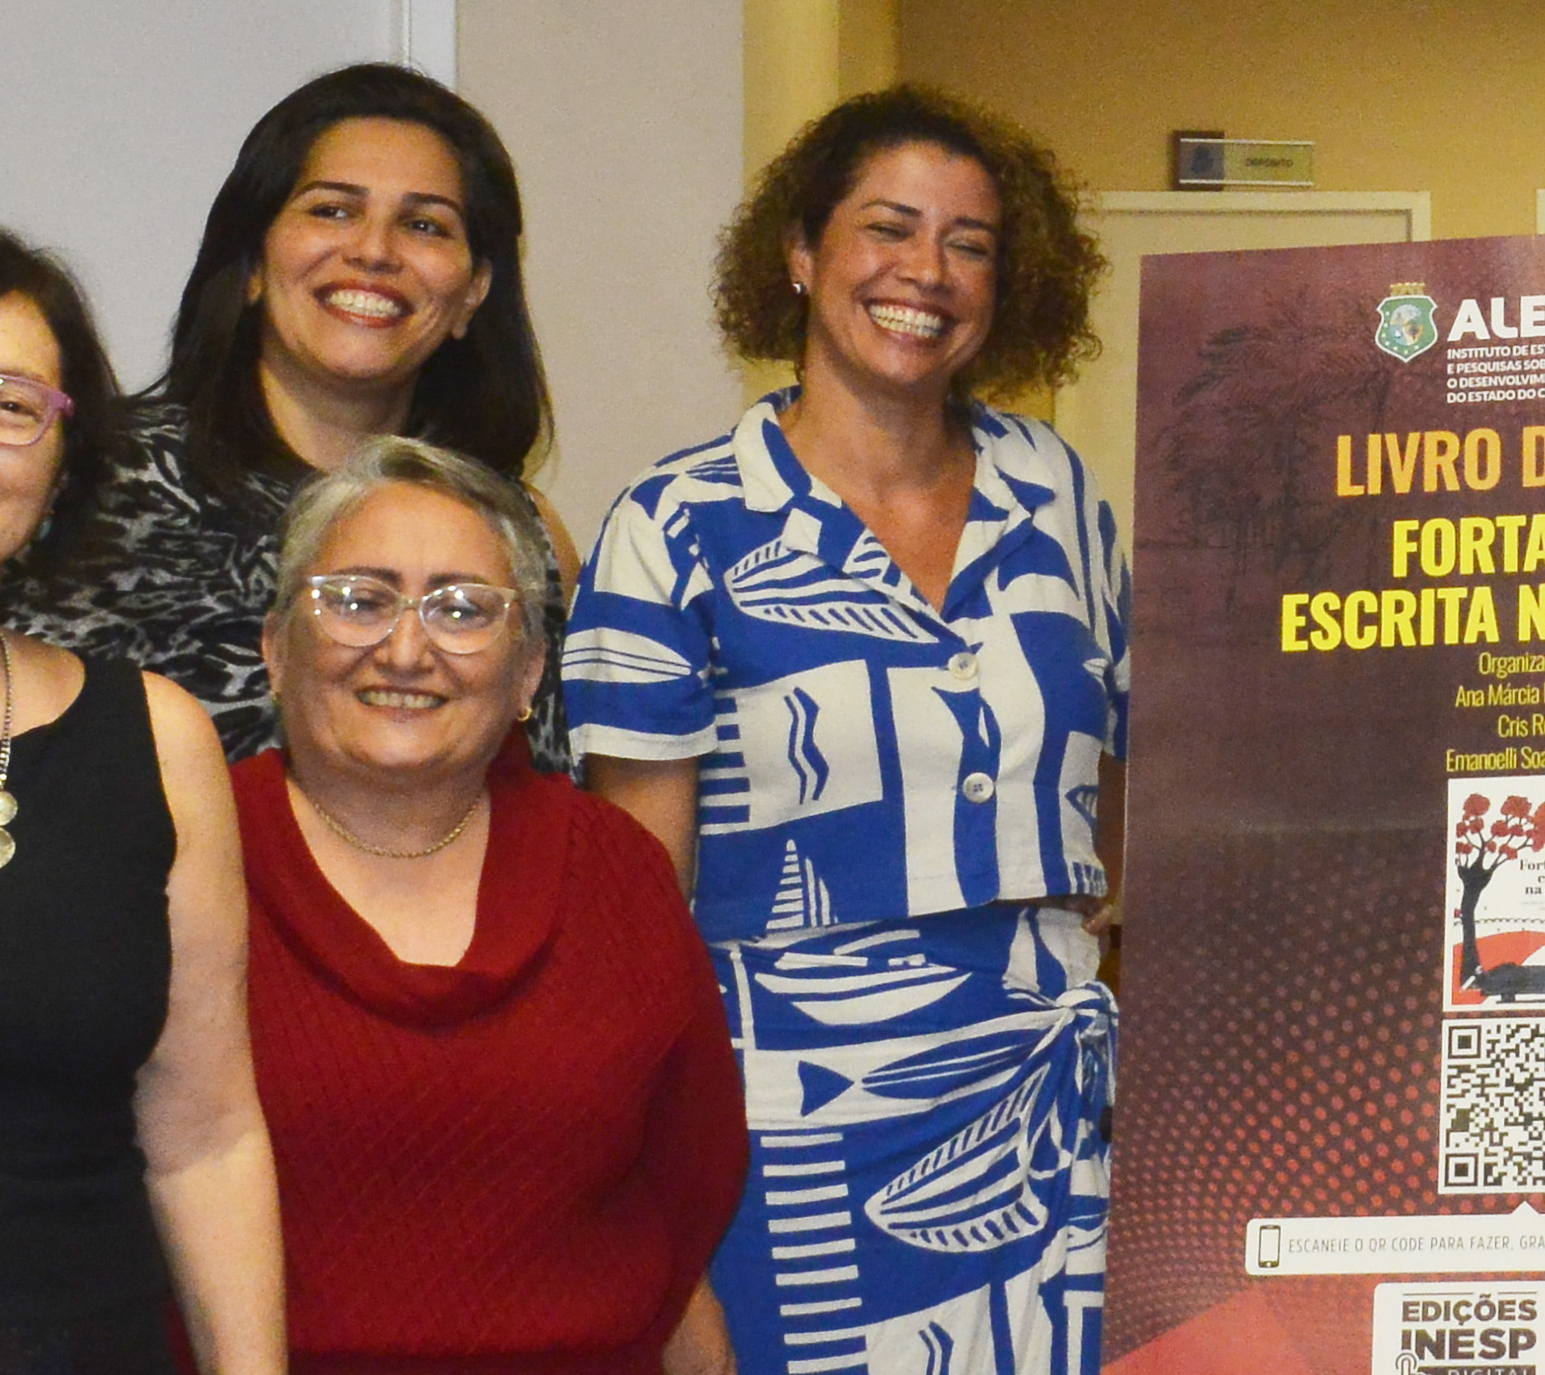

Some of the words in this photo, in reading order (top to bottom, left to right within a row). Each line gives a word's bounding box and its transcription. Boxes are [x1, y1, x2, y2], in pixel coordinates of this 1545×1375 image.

[1447, 346, 1509, 360] INSTITUTO
[1512, 345, 1529, 357] DE
[1447, 363, 1455, 374] E
[1456, 360, 1522, 374] PESQUISAS
[1447, 377, 1458, 389] O
[1447, 392, 1466, 403] DO
[1468, 389, 1516, 402] ESTADO
[1517, 387, 1536, 399] DO
[1337, 428, 1501, 497] LIVRO
[1281, 586, 1499, 652] ESCRITA
[1455, 685, 1484, 707] Ana
[1488, 682, 1540, 706] Márcia
[1498, 714, 1528, 738] Cris
[1525, 886, 1542, 894] na
[1288, 1238, 1349, 1253] ESCANEIE
[1355, 1238, 1363, 1252] O
[1369, 1237, 1386, 1253] QR
[1391, 1237, 1424, 1251] CODE
[1430, 1236, 1464, 1250] PARA
[1402, 1294, 1537, 1325] EDIÇÕES
[1401, 1328, 1537, 1360] INESP
